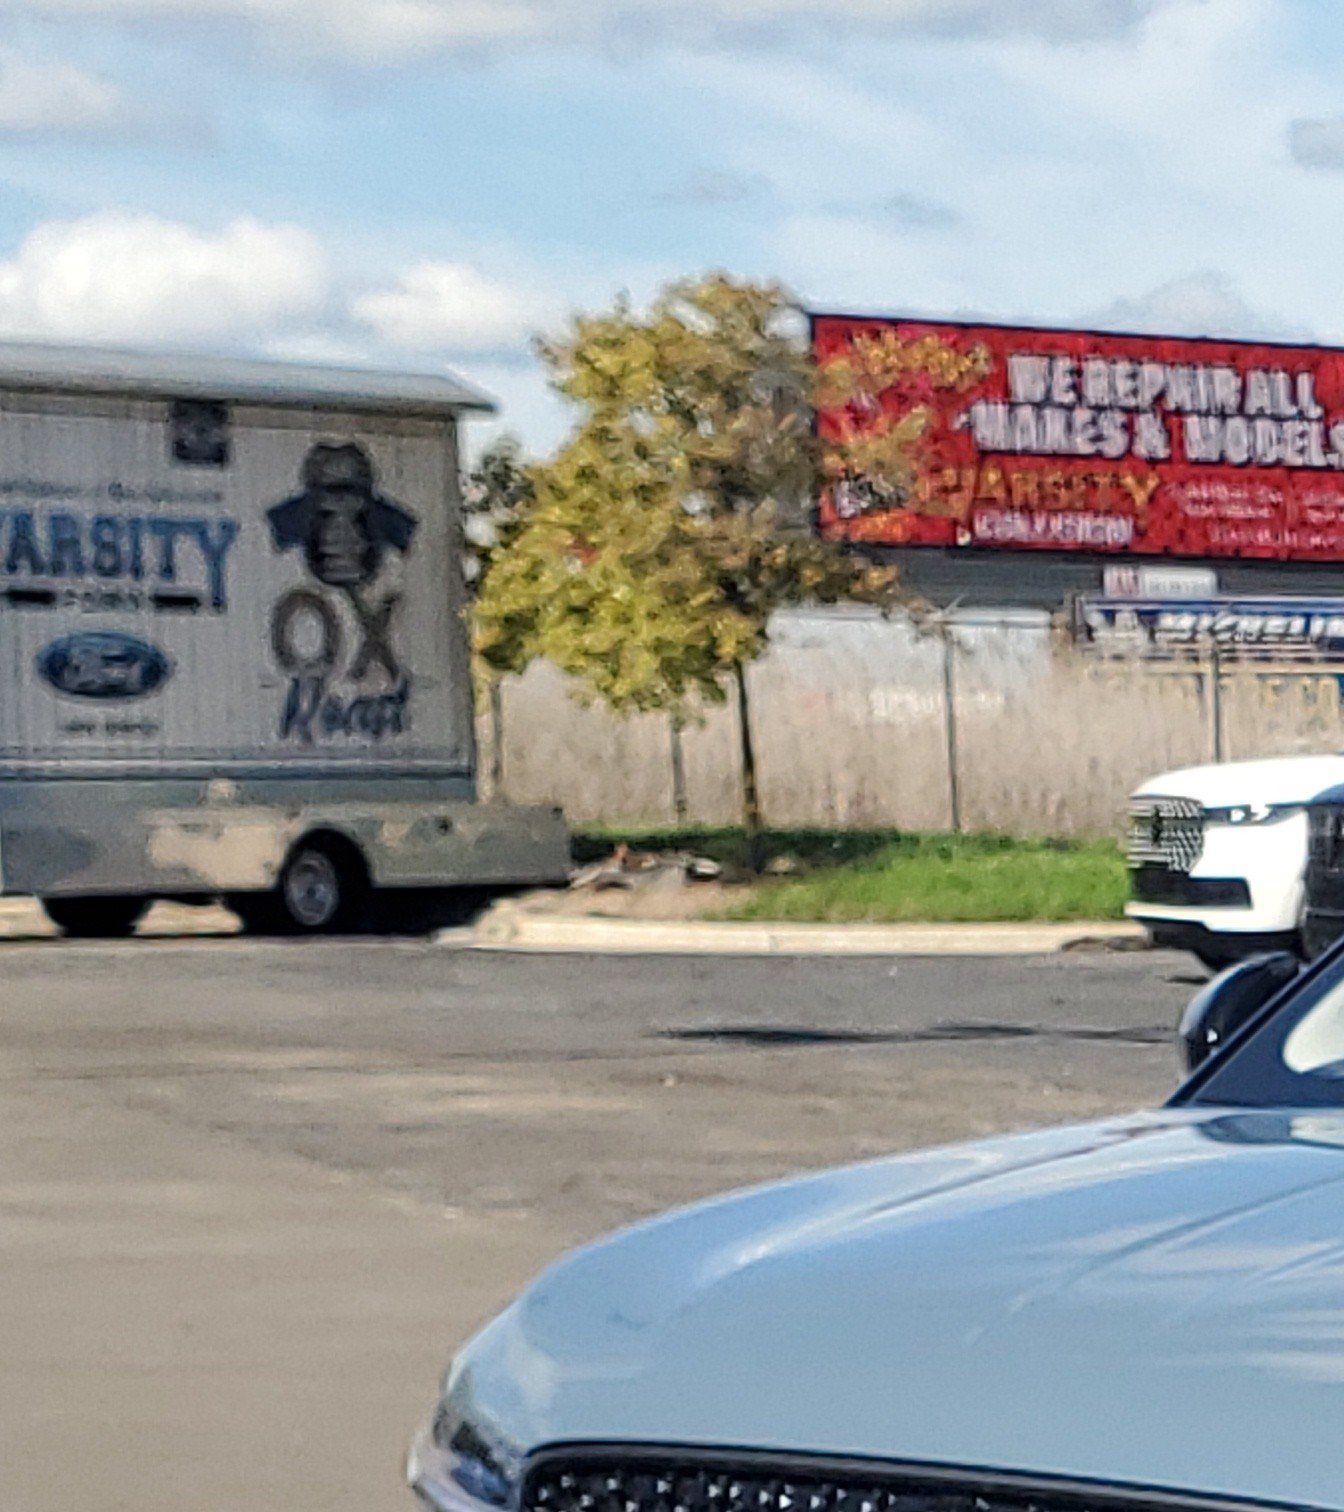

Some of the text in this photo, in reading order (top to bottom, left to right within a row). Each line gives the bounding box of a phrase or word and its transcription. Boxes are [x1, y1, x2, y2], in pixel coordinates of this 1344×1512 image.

[1007, 353, 1078, 404] WE
[1081, 356, 1243, 415] REPAIR
[1244, 367, 1325, 419] ALL
[970, 399, 1131, 459] MAKES
[0, 511, 240, 615] ARSITY
